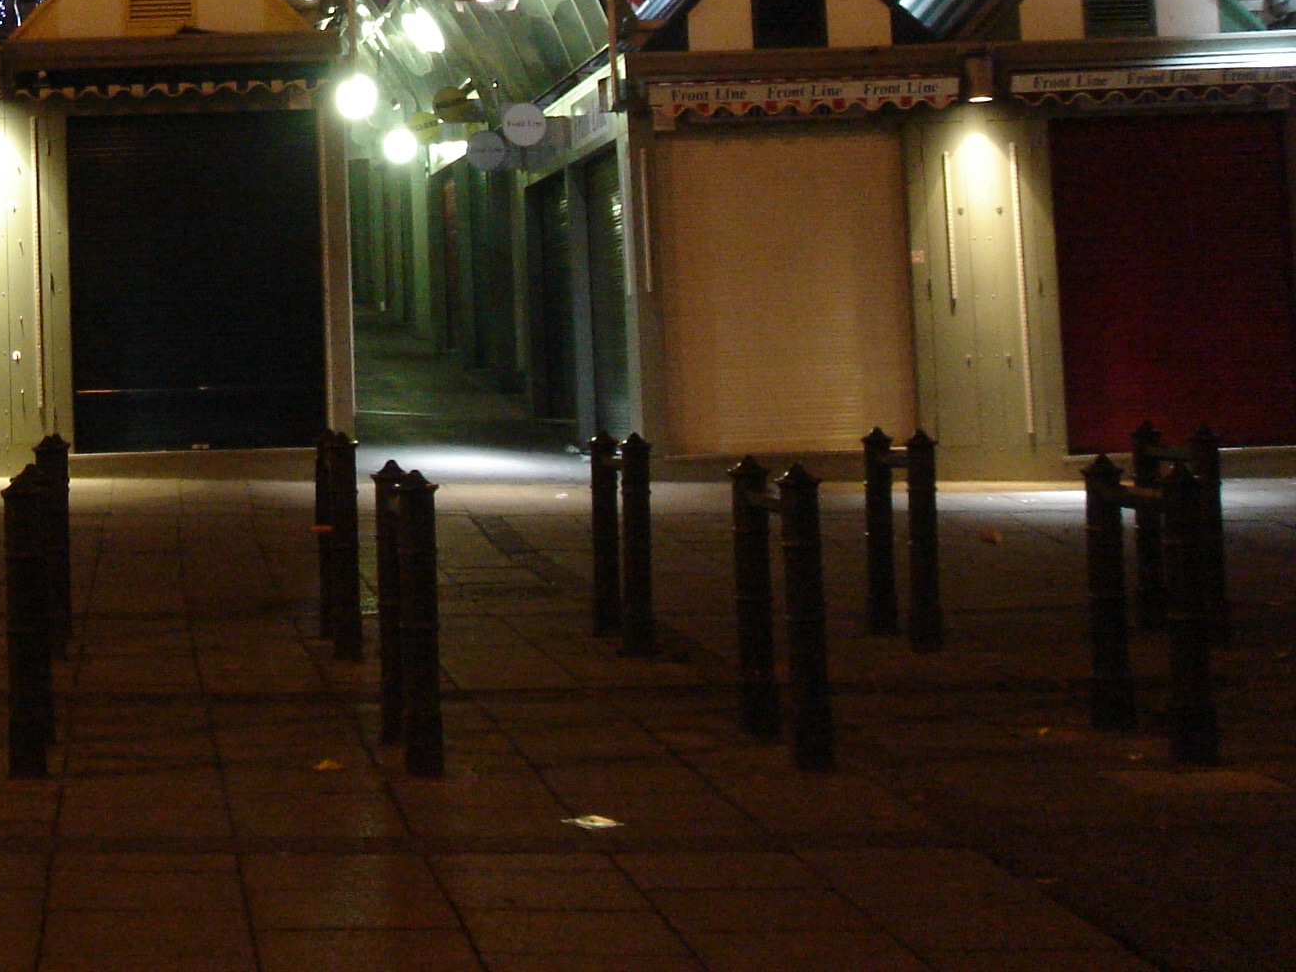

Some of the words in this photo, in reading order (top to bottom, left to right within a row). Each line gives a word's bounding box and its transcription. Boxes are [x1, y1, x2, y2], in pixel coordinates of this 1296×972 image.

[672, 90, 709, 101] Front
[715, 88, 747, 99] Line
[768, 87, 804, 98] Front
[863, 84, 900, 95] Front
